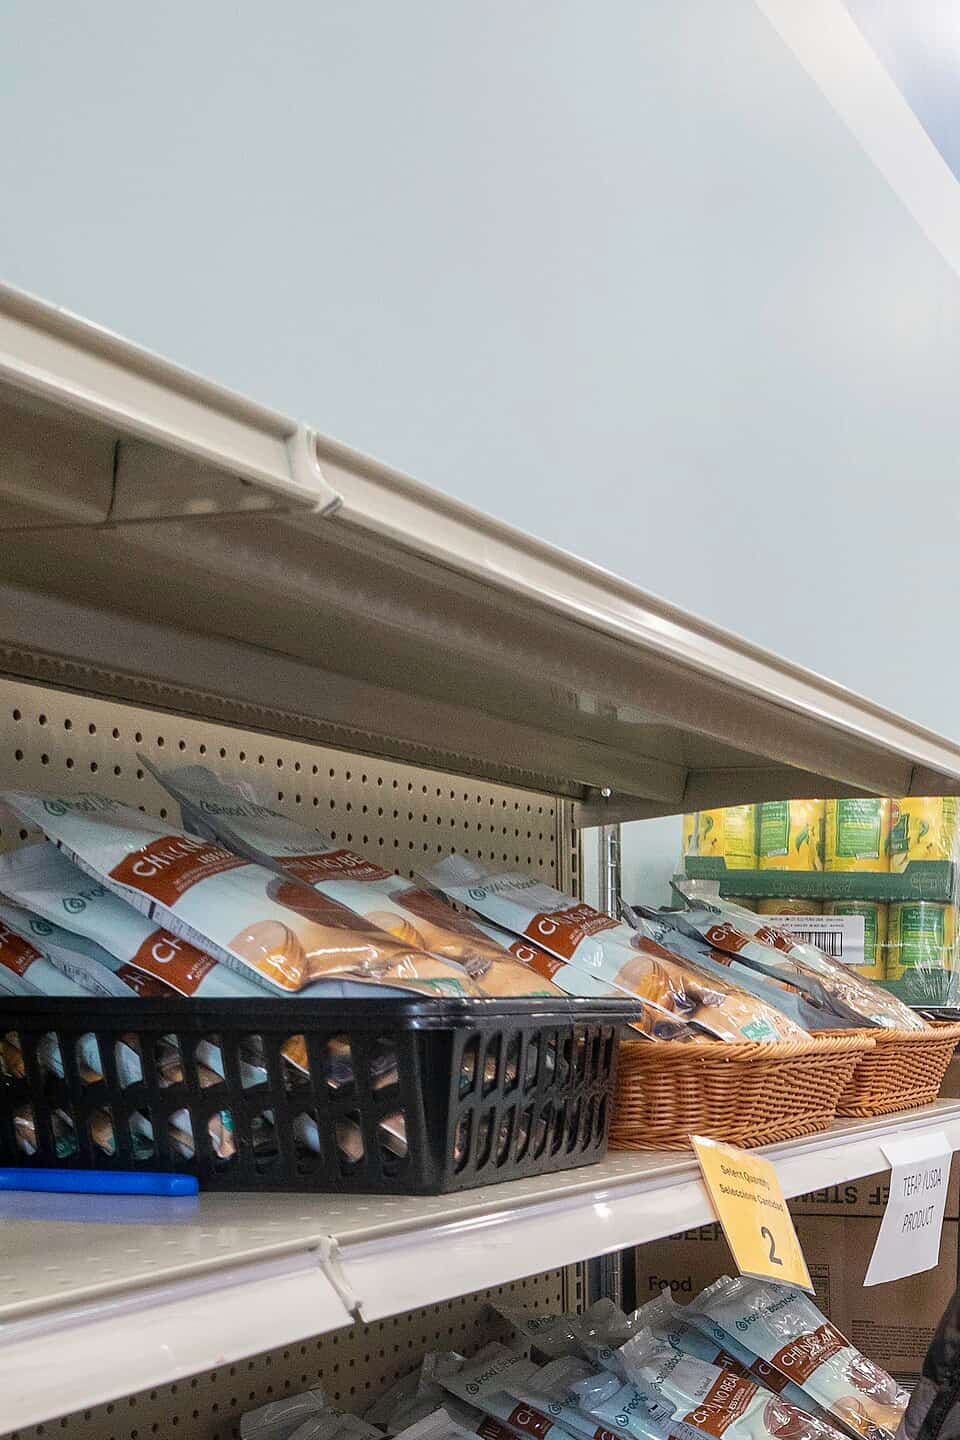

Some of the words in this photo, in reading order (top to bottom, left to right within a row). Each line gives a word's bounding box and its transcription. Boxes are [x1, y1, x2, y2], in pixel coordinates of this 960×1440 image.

[902, 1205, 936, 1234] PRODUCT
[761, 1226, 783, 1266] 2
[648, 1275, 692, 1292] Food
